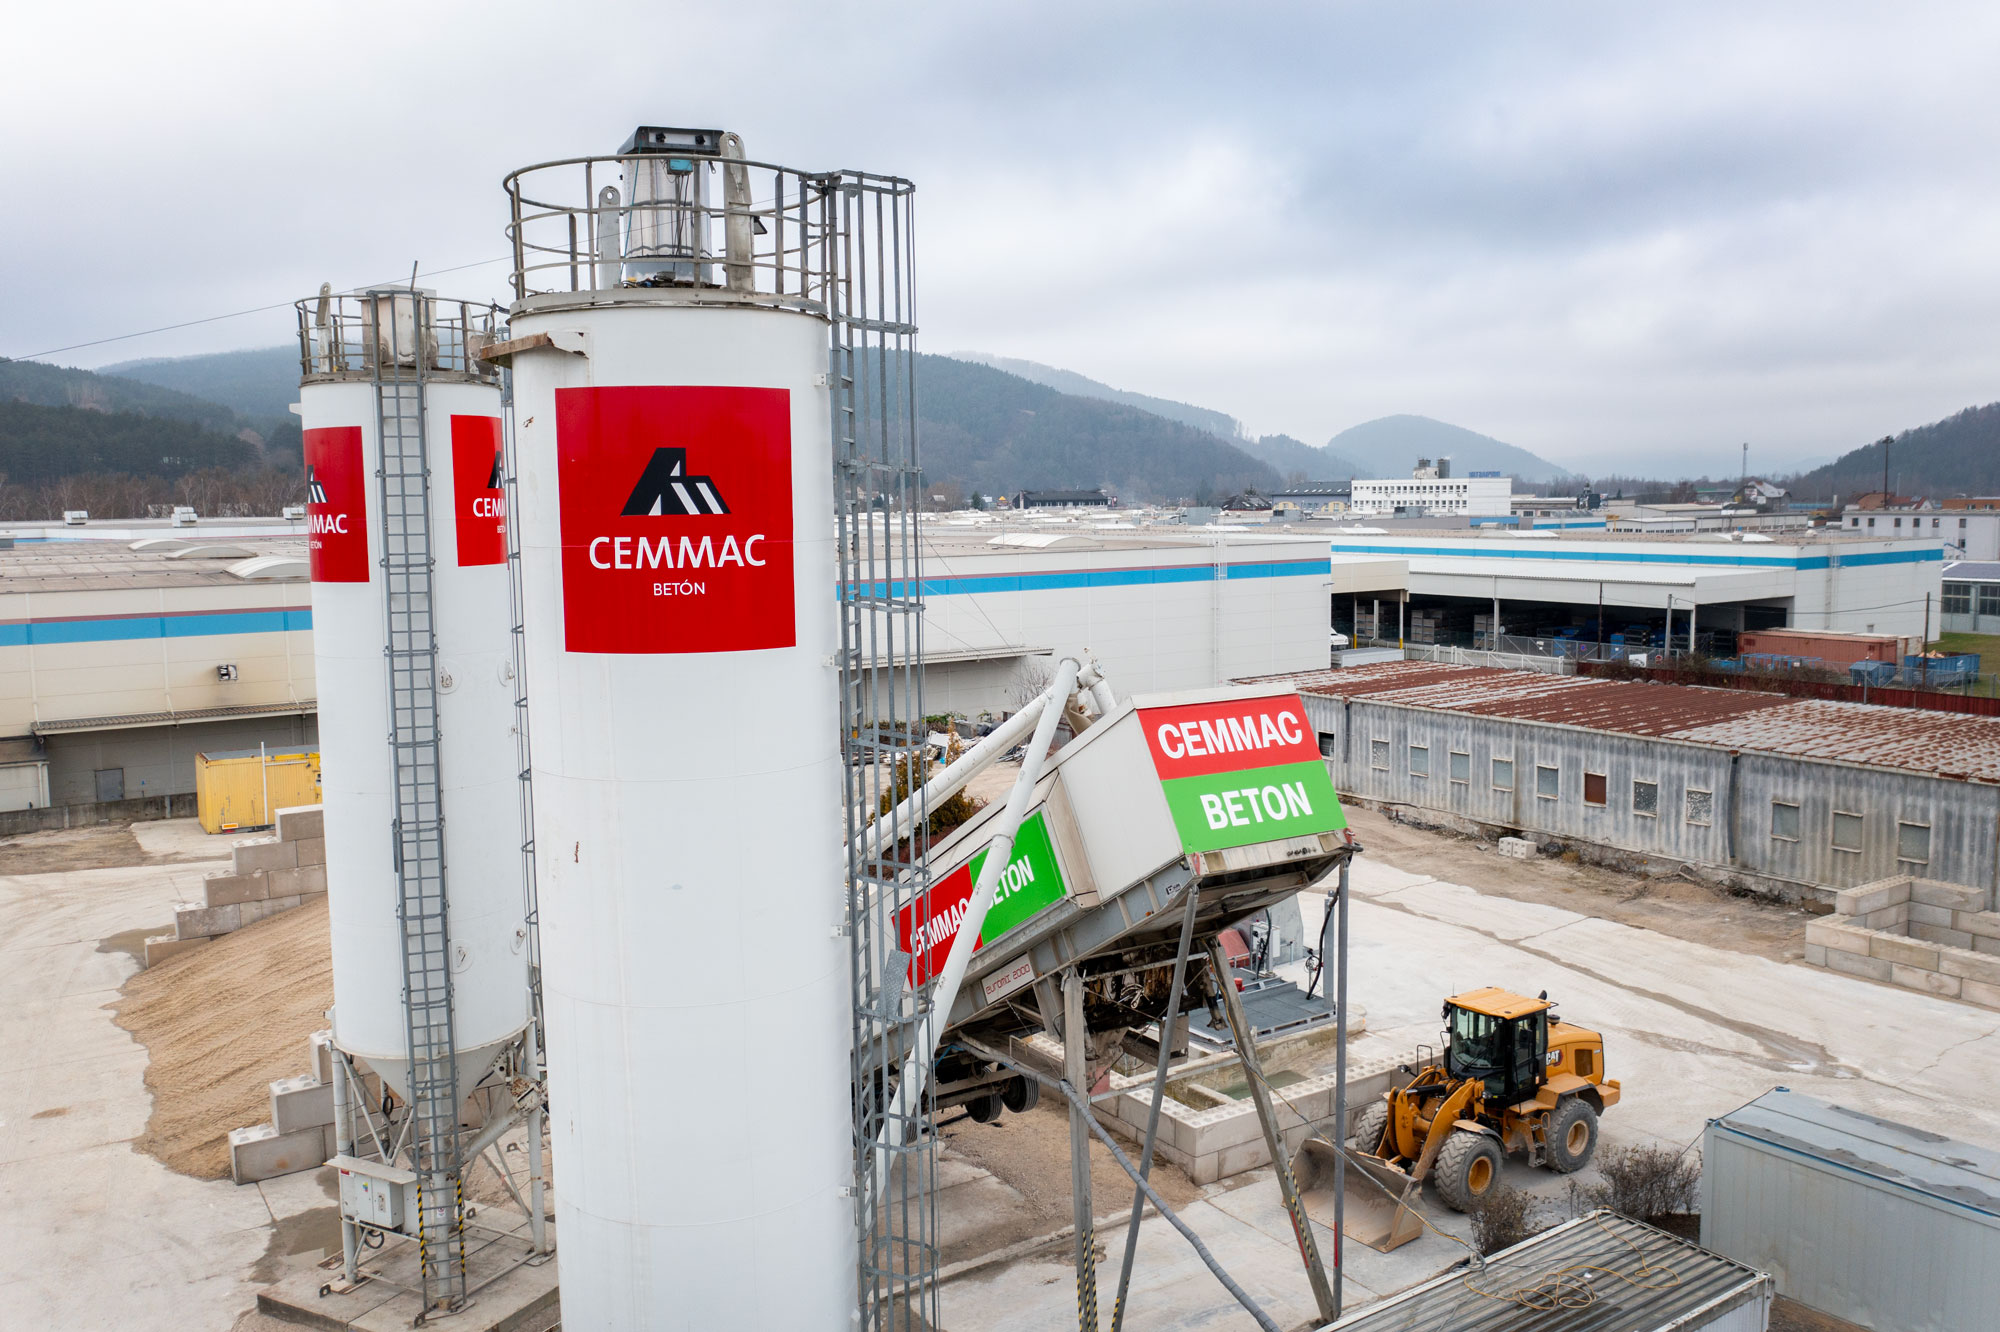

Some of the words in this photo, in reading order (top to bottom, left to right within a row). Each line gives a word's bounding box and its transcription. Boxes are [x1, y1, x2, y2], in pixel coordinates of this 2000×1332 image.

[588, 533, 767, 570] CEMMAC
[652, 578, 706, 597] BETÓN
[1157, 710, 1303, 759] CEMMAC
[1199, 781, 1314, 830] BETON
[987, 854, 1035, 911] ETON
[1012, 963, 1031, 980] 2000
[1546, 1050, 1560, 1066] CAT
